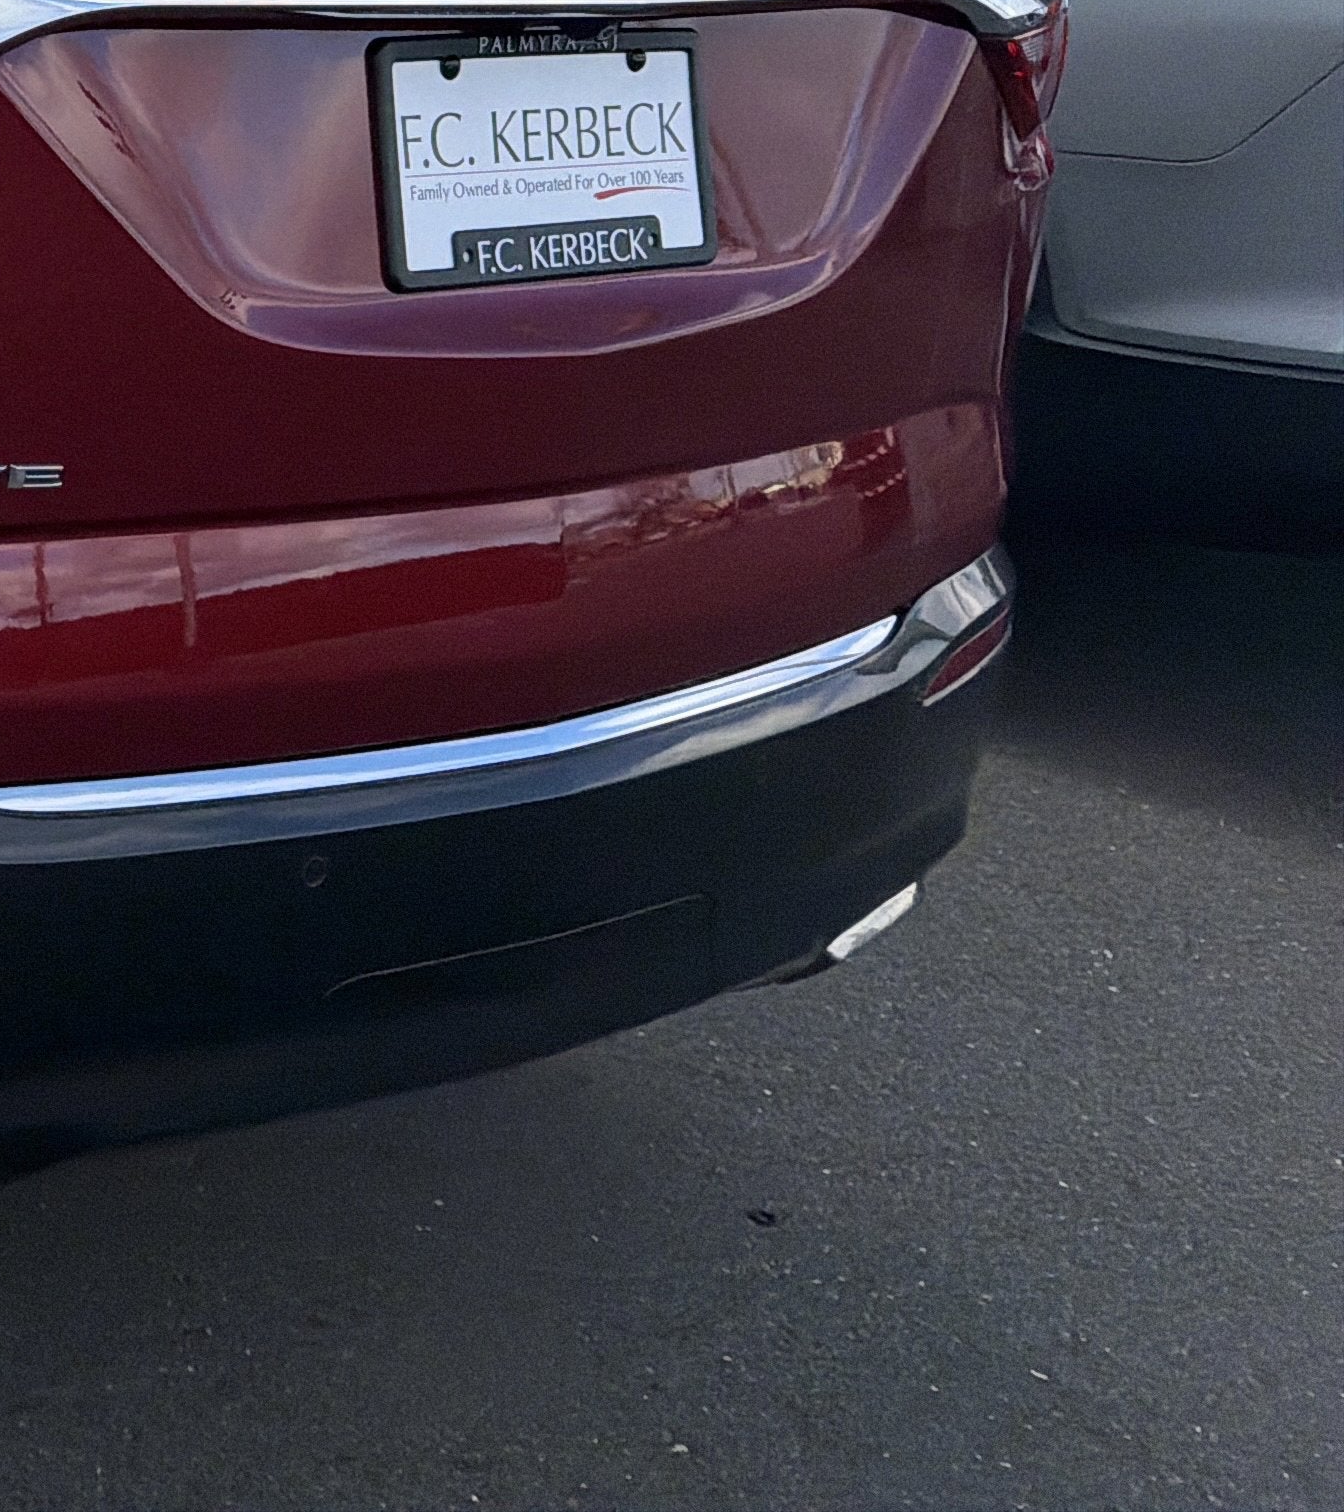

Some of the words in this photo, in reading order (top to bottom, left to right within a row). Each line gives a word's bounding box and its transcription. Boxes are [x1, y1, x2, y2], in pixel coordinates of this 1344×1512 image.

[400, 112, 476, 170] F.C.
[490, 101, 687, 164] KERBECK
[409, 182, 450, 202] Family
[452, 178, 499, 199] Owned
[502, 179, 512, 195] &
[515, 173, 572, 197] Operated
[574, 174, 594, 191] For
[597, 172, 626, 188] Over
[630, 170, 651, 186] 100
[653, 168, 685, 184] Years
[477, 237, 524, 275] F.C.
[529, 227, 648, 270] KERBECK
